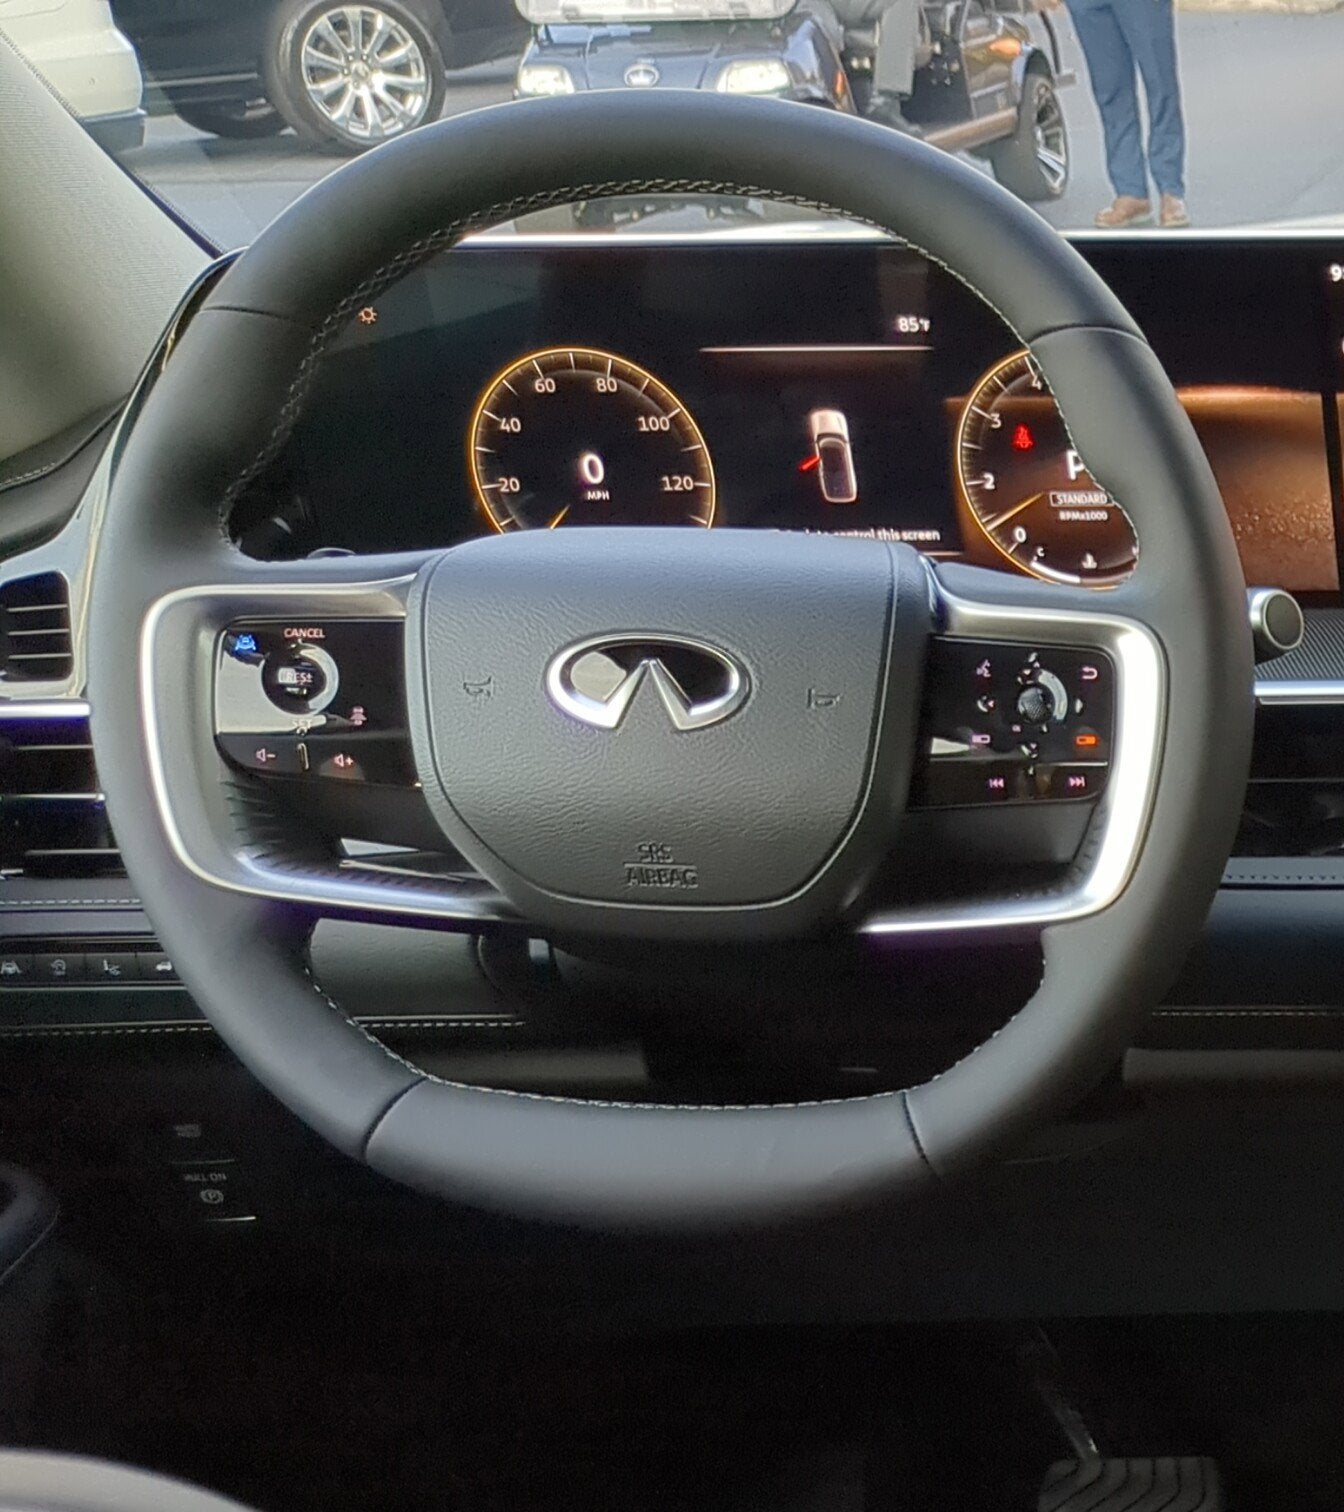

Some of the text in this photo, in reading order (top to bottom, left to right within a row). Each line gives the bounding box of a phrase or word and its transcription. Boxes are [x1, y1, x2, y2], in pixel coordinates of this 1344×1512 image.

[534, 378, 556, 393] 60
[596, 377, 618, 393] 80
[1029, 376, 1042, 390] 4
[500, 417, 522, 433] 40
[637, 417, 670, 432] 100
[990, 413, 1002, 429] 3
[582, 453, 605, 484] 0
[1065, 450, 1086, 480] P
[500, 478, 521, 492] 20
[662, 476, 694, 491] 120
[983, 473, 996, 490] 2
[587, 490, 611, 501] MPH
[1056, 493, 1108, 505] STANDARD
[877, 527, 900, 541] this
[901, 530, 941, 541] screen
[1013, 527, 1027, 543] 0
[284, 628, 327, 638] CANCEL
[637, 842, 674, 863] SRS
[624, 867, 698, 888] AIRBAG
